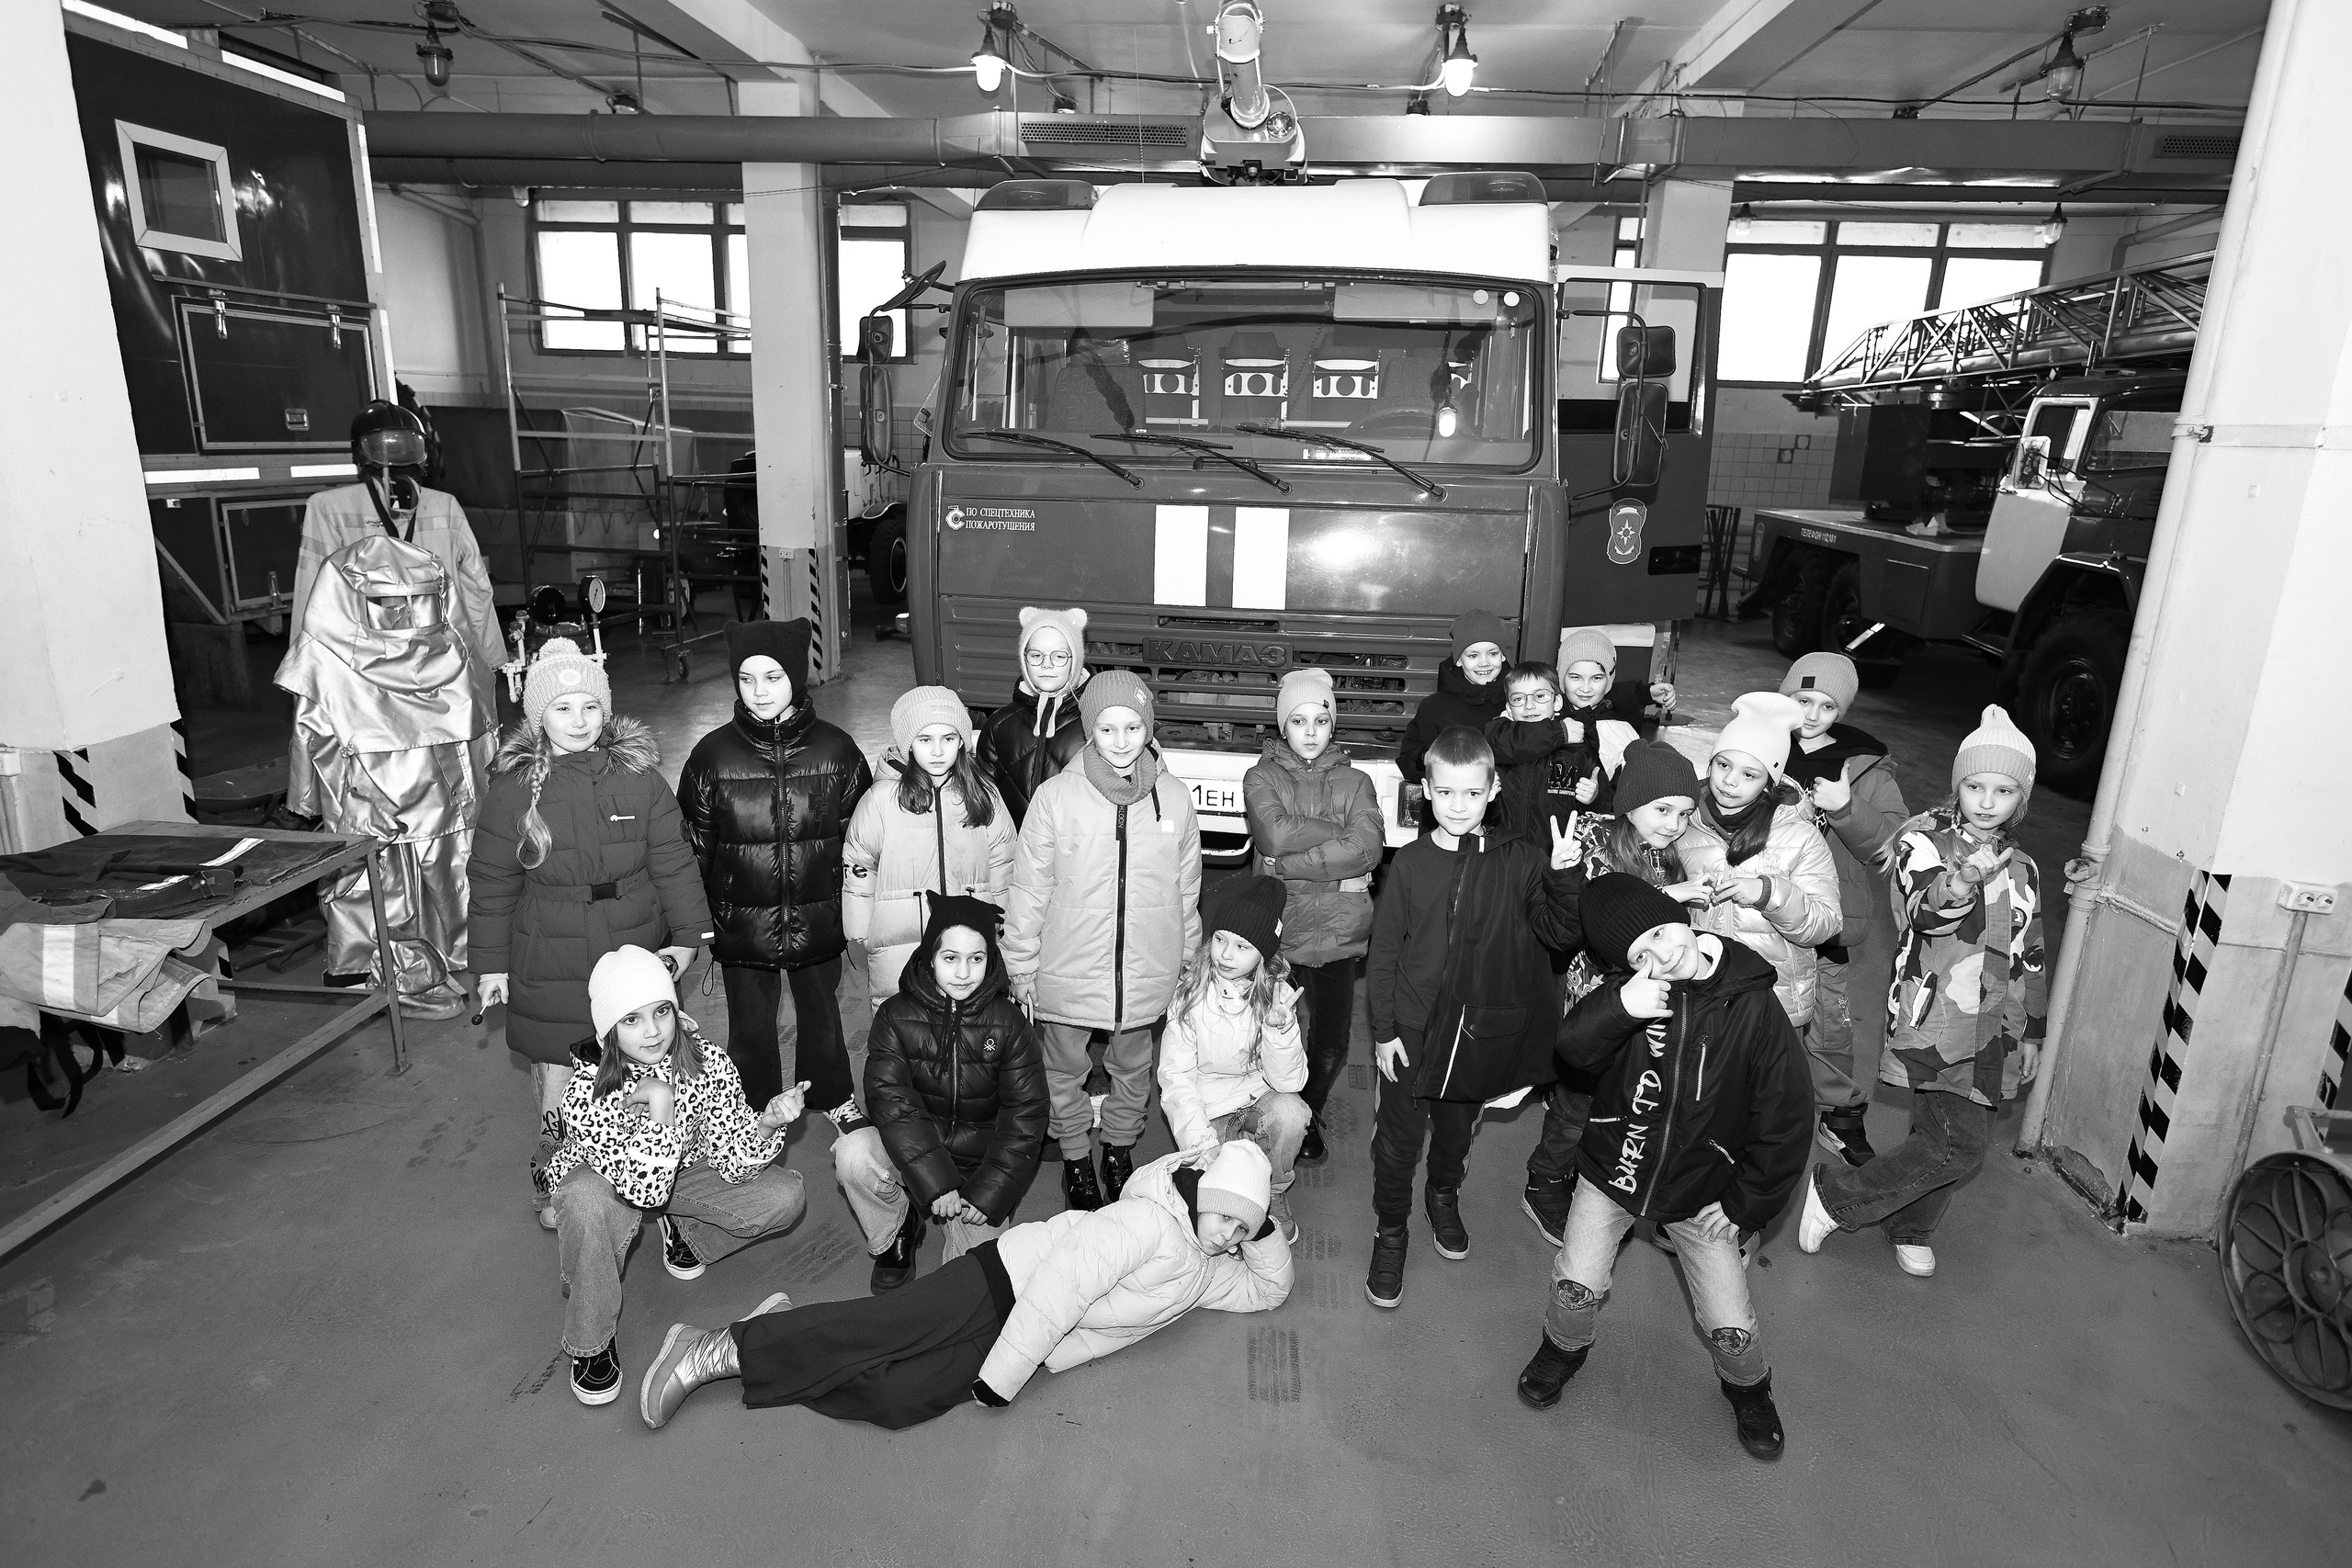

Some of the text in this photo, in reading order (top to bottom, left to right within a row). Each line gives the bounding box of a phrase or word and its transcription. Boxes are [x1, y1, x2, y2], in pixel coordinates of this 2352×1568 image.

[966, 507, 1035, 519] ПО СПЕЦТЕХНИКА
[966, 520, 1035, 531] ПОЖАРОТУШЕНИЯ
[1801, 527, 1822, 540] ТЕЛЕФОН
[1148, 640, 1287, 669] КАМАЗ
[1608, 1123, 1649, 1195] BURN
[1632, 1069, 1661, 1115] TO
